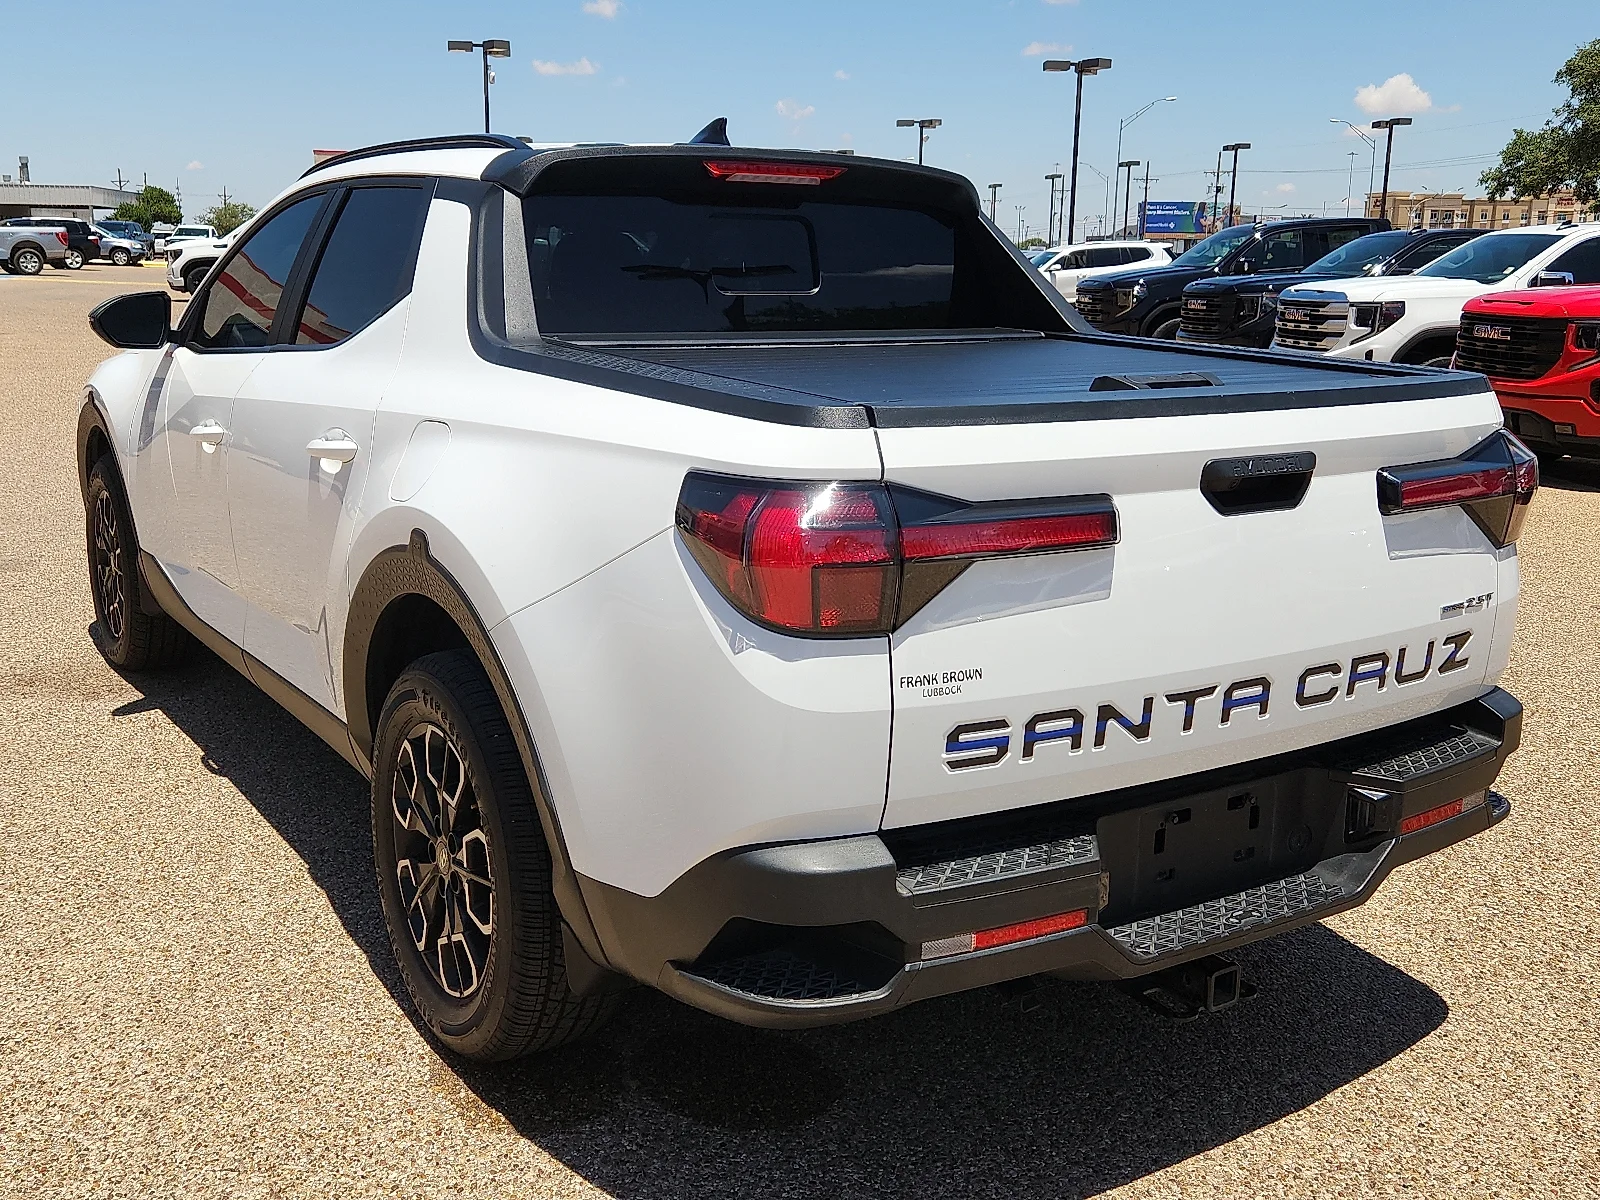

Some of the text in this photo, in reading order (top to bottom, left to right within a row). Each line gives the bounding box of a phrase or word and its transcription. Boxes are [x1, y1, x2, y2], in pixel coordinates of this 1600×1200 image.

[1285, 308, 1311, 321] GMC
[1473, 324, 1512, 341] GMC
[1231, 454, 1304, 477] HYUNDAI
[900, 667, 983, 689] FRANK BROWN
[922, 684, 962, 698] LUBBOCK
[942, 629, 1475, 774] SANTA CRUZ
